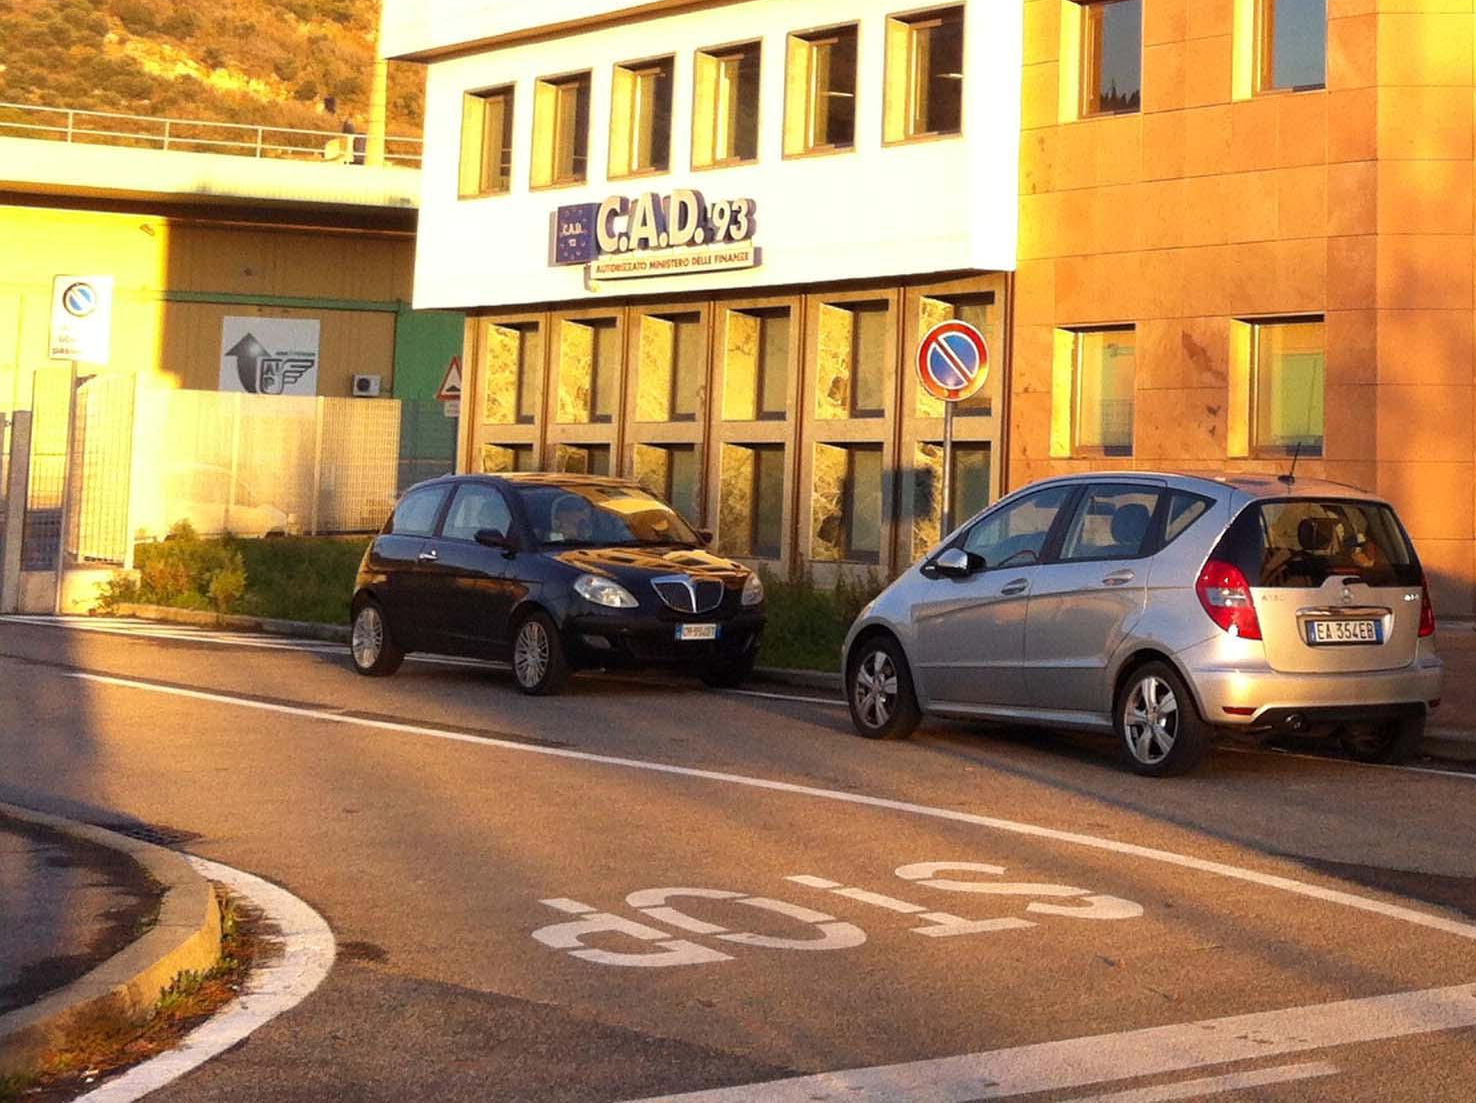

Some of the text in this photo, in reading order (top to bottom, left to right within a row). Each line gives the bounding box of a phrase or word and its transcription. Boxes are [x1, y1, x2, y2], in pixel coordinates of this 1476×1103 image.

[597, 189, 704, 252] C.A.D.
[596, 251, 750, 273] AUTORIZZATO MINISTERO DELLE FINANZE
[531, 860, 1145, 968] STOP
